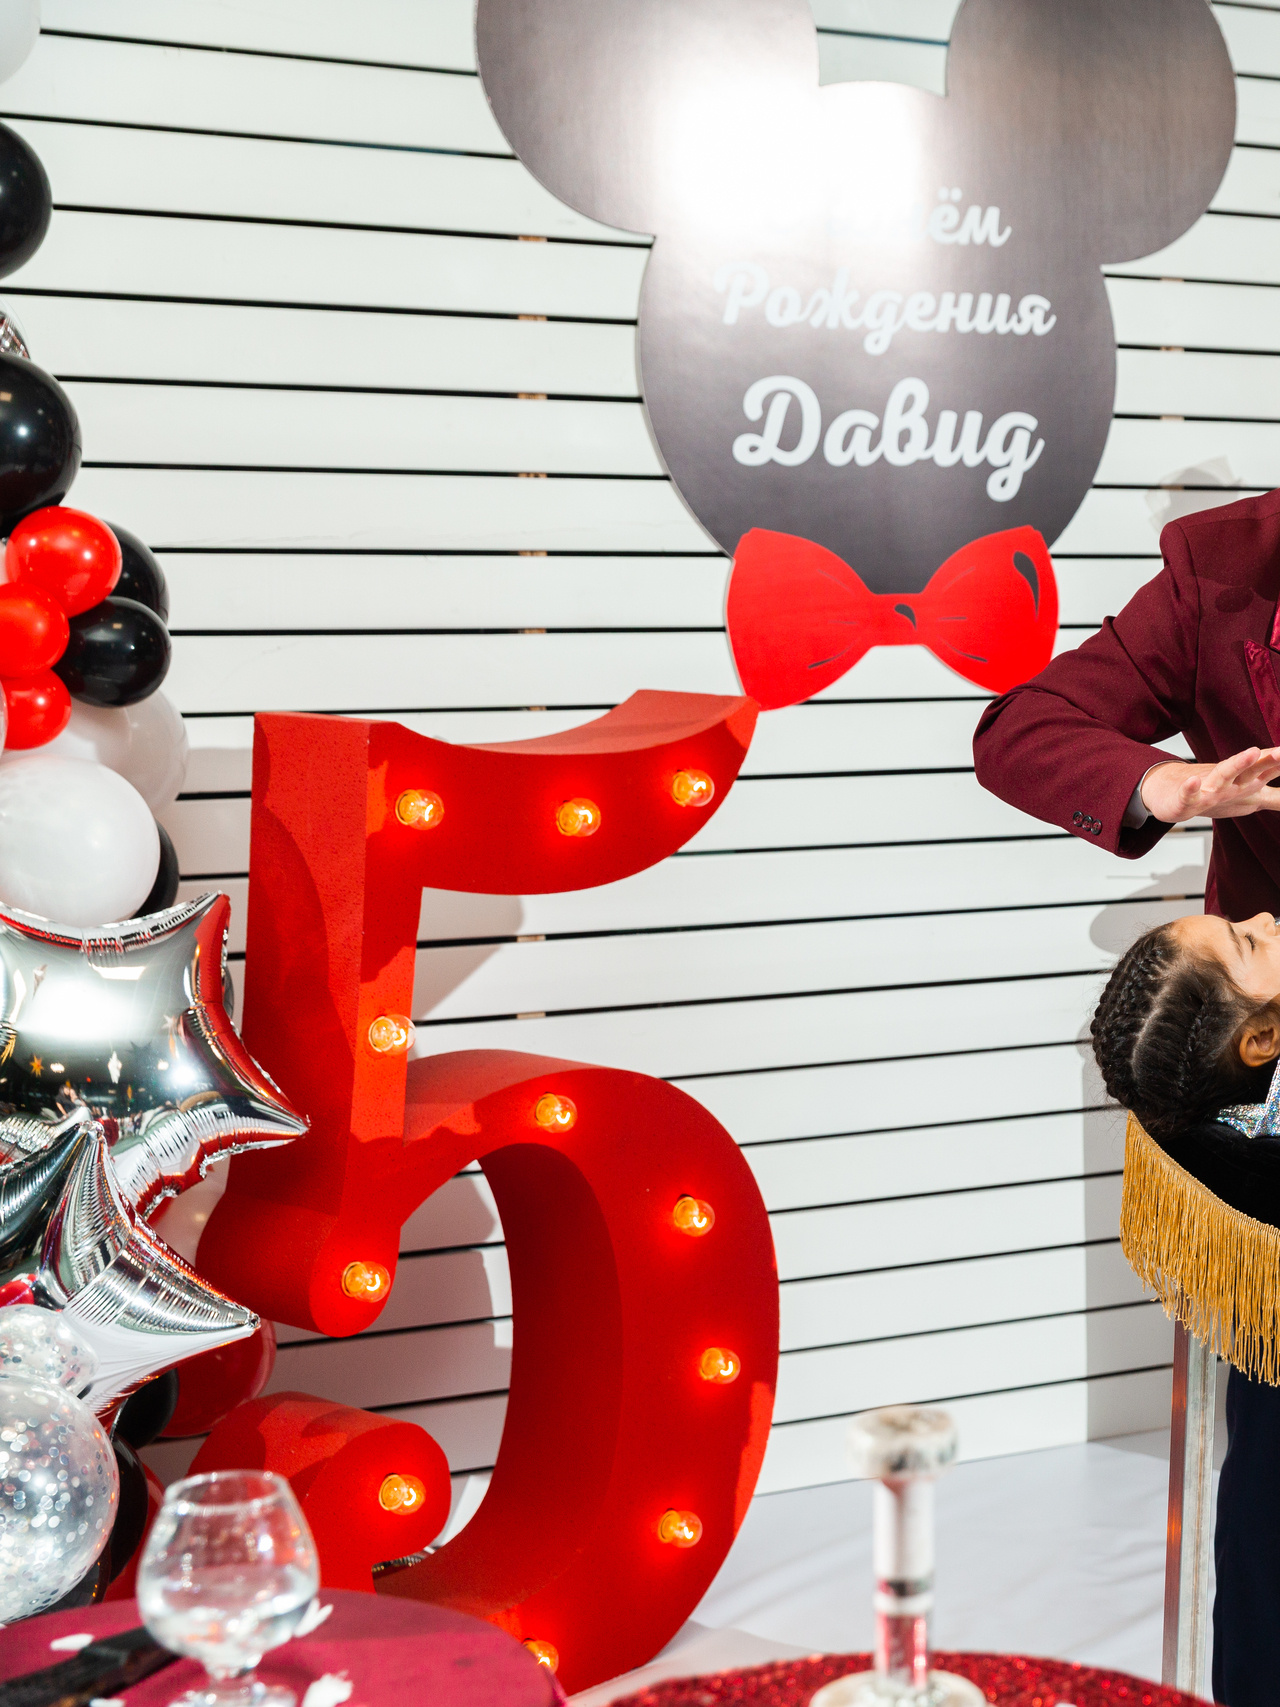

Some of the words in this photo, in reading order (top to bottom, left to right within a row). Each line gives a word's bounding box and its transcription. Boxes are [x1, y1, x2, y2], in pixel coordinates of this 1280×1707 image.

[713, 261, 1056, 356] Рождения
[732, 374, 1045, 502] Давид
[197, 689, 779, 1694] 5
